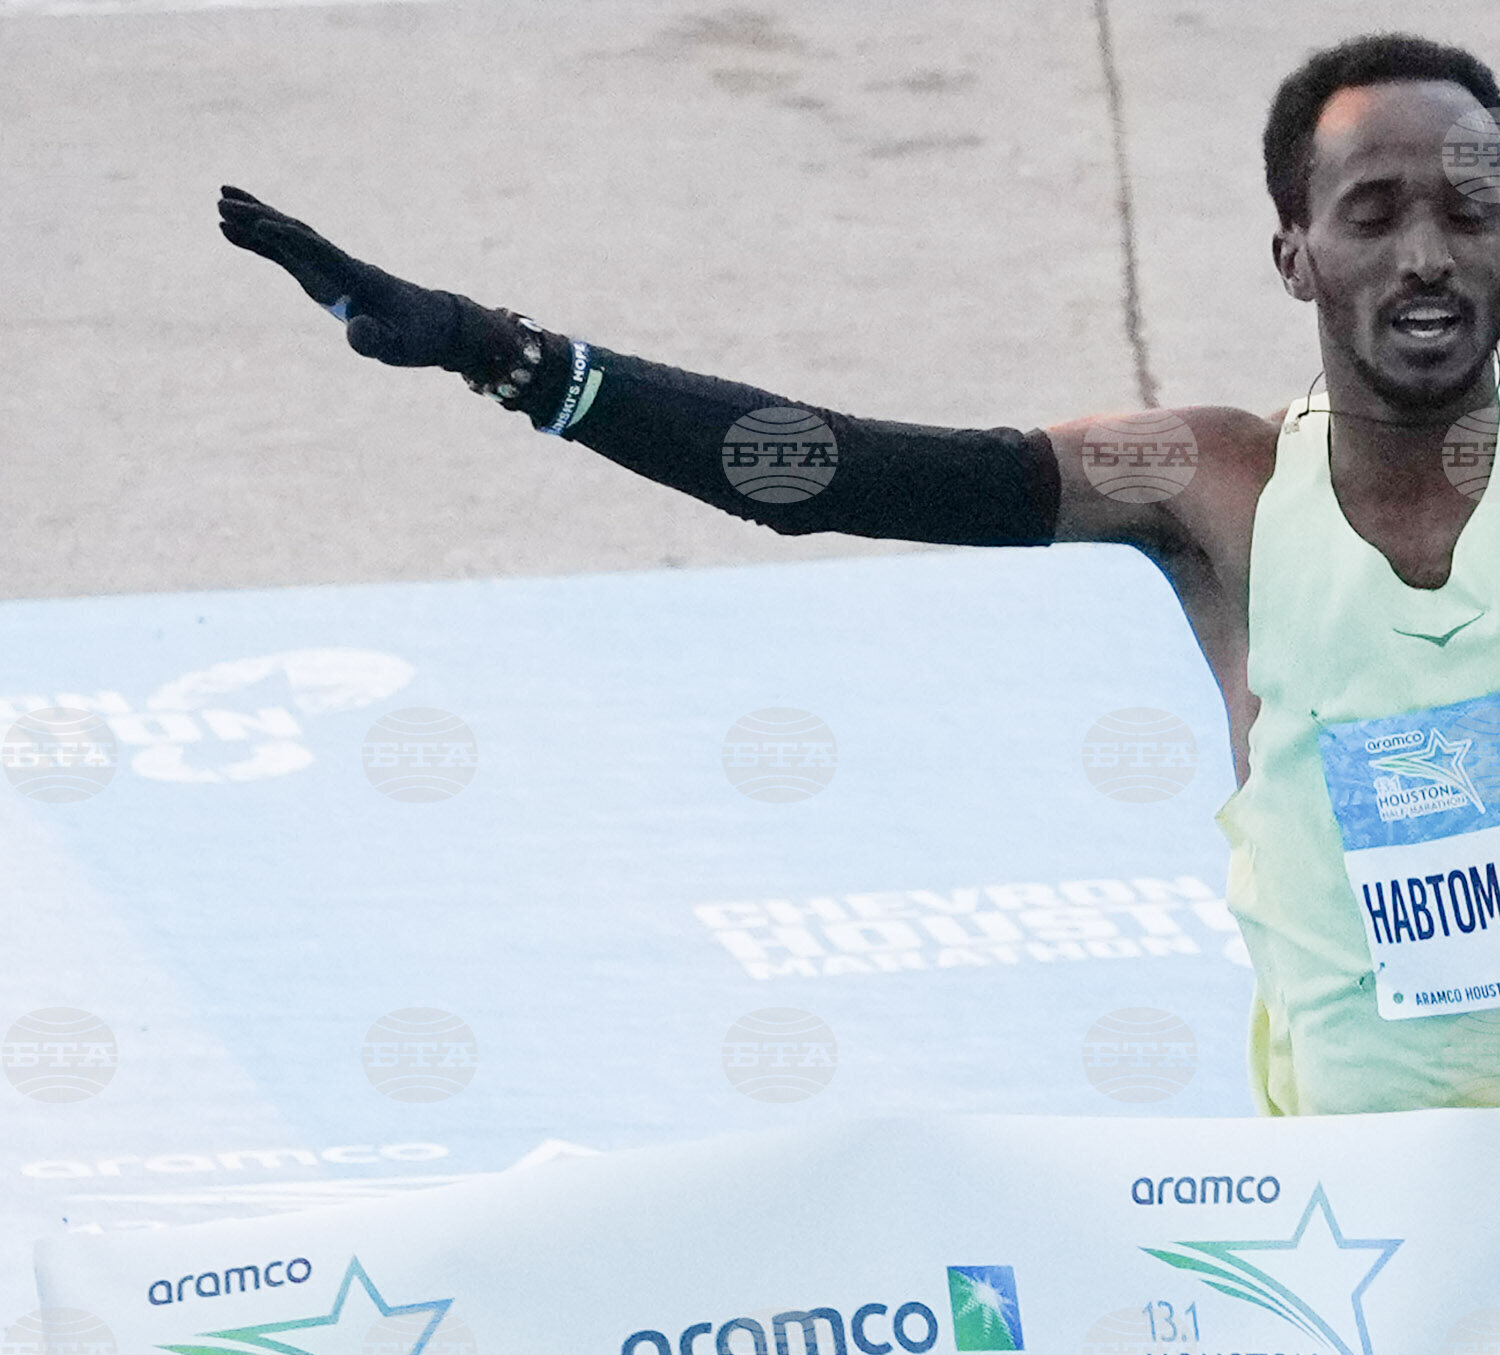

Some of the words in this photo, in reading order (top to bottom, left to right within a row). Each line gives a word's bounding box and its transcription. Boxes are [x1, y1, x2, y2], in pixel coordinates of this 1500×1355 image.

[1366, 732, 1422, 750] aramco
[1378, 785, 1449, 809] HOUSTON
[1415, 988, 1462, 1006] ARAMCO
[21, 1142, 449, 1179] aramco
[1132, 1175, 1280, 1205] aramco
[148, 1257, 312, 1306] aramco
[1142, 1300, 1201, 1343] 13.1
